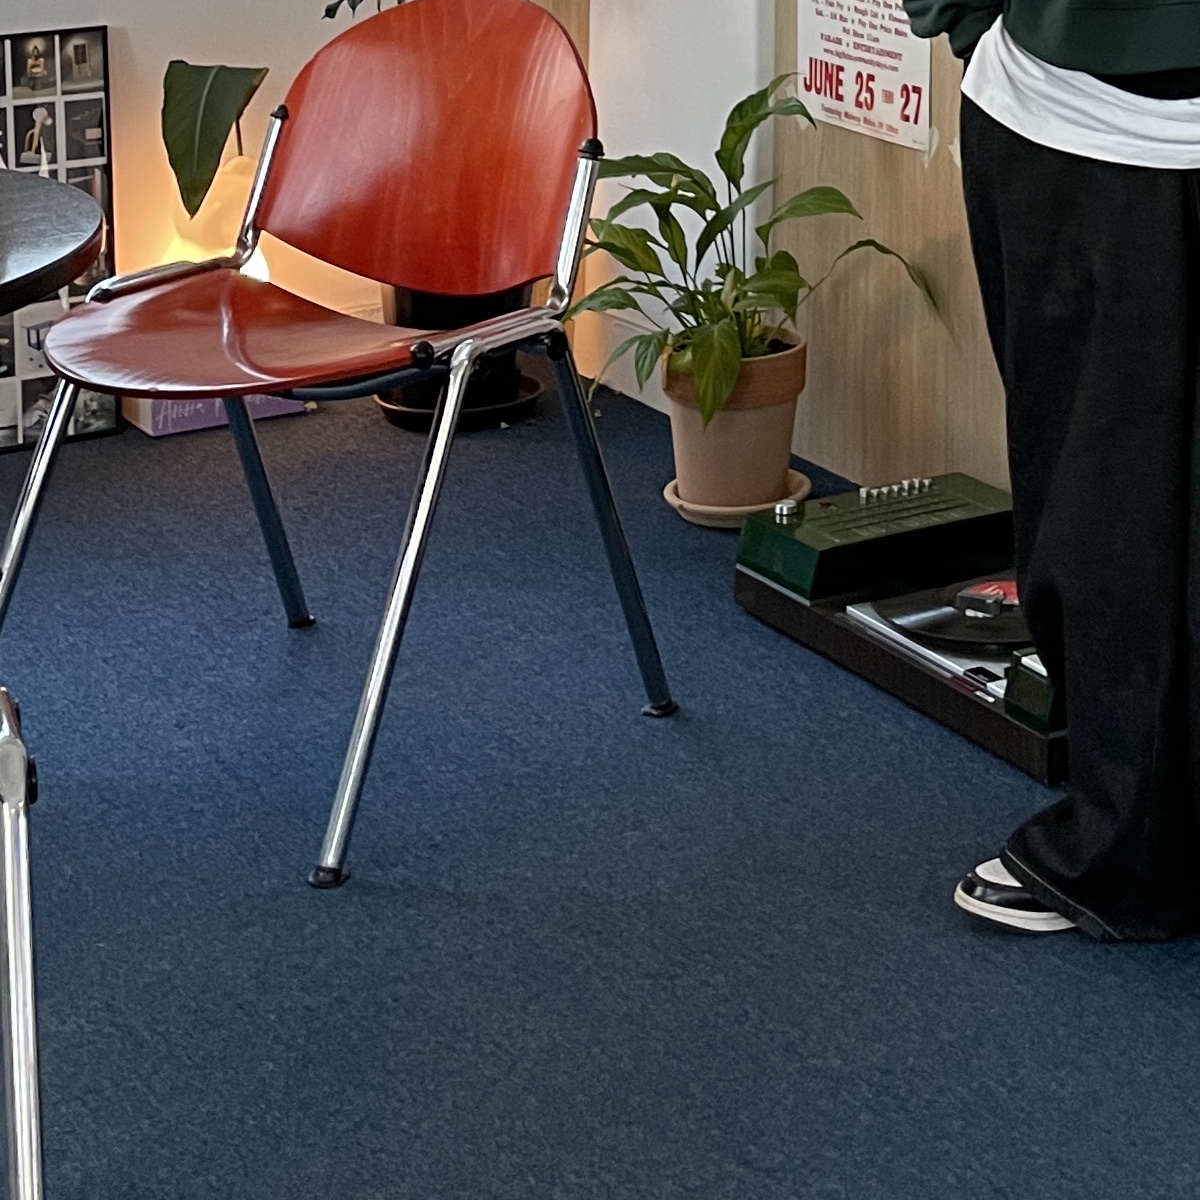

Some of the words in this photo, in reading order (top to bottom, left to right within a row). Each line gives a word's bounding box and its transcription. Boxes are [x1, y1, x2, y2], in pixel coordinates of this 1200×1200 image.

[804, 56, 844, 103] JUNE
[855, 70, 875, 111] 25
[900, 83, 922, 125] 27
